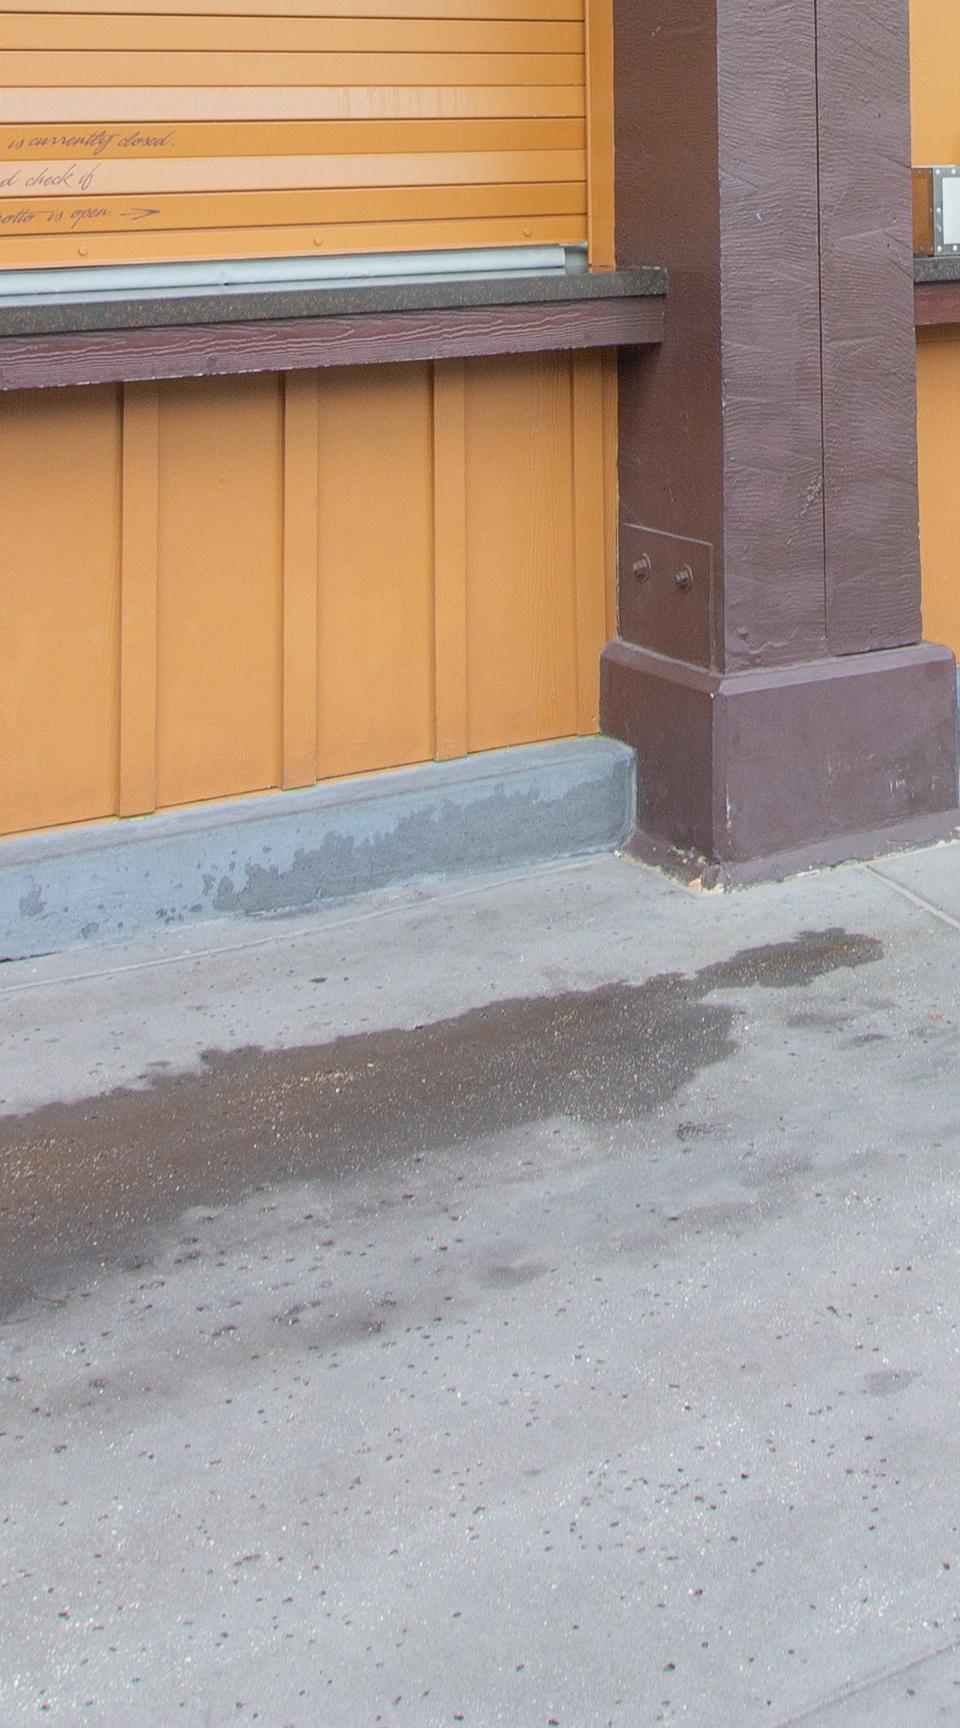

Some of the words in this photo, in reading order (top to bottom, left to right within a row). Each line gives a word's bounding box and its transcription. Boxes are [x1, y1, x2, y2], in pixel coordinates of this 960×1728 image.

[8, 137, 24, 150] is
[29, 130, 120, 156] currently
[118, 131, 176, 149] closed.
[25, 163, 76, 188] check
[78, 163, 101, 190] if
[48, 209, 63, 223] is
